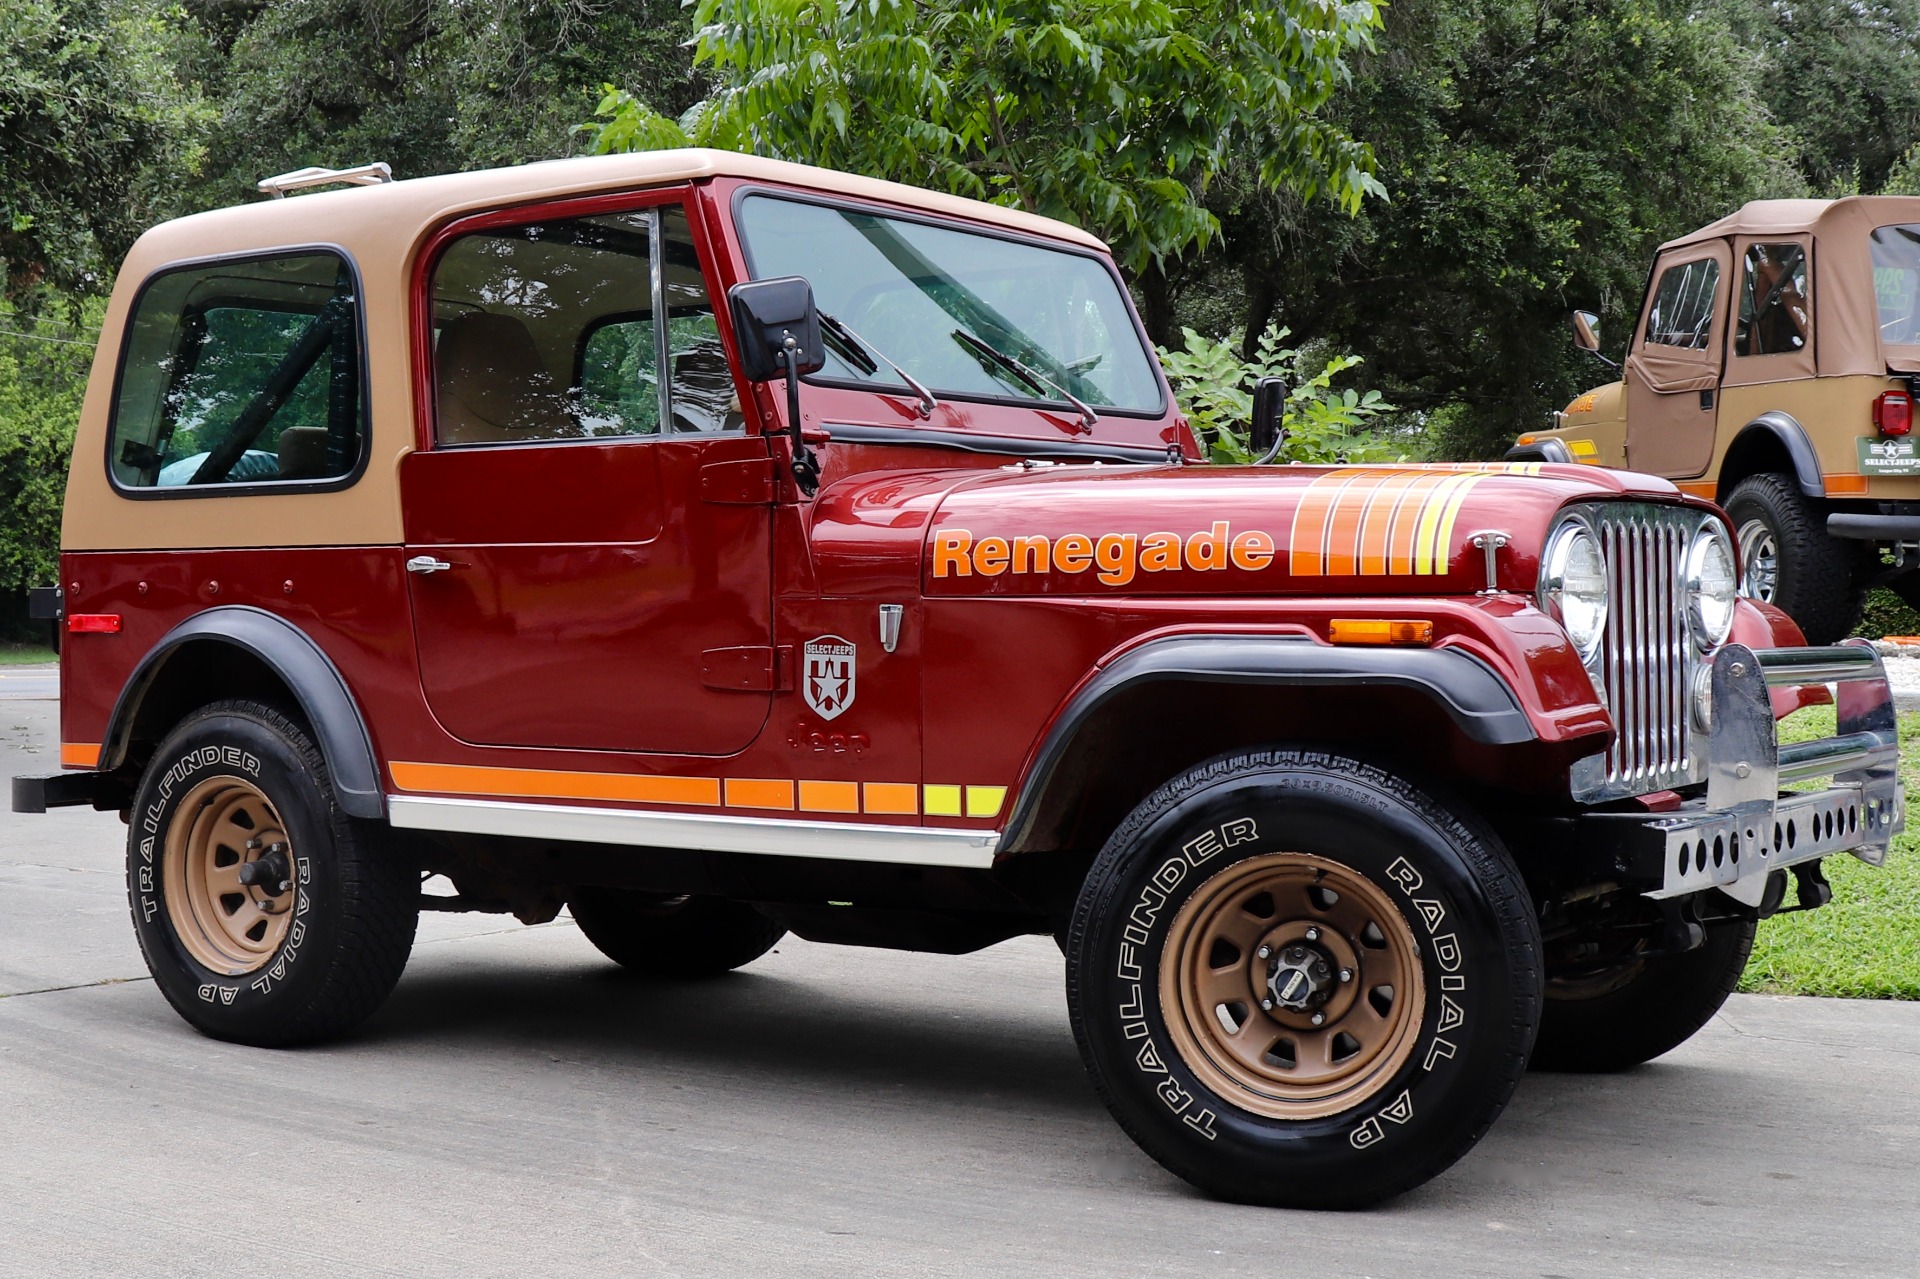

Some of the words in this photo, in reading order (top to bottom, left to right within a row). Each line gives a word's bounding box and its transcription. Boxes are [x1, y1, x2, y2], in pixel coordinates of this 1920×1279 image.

[933, 521, 1275, 587] Renegade
[139, 745, 261, 923] TRAILFINDER
[198, 983, 240, 1005] AP
[252, 857, 311, 995] RADIAL
[1117, 817, 1260, 1142] TRAILFINDER
[1386, 856, 1465, 1073] RADIAL
[1350, 1088, 1416, 1151] AP
